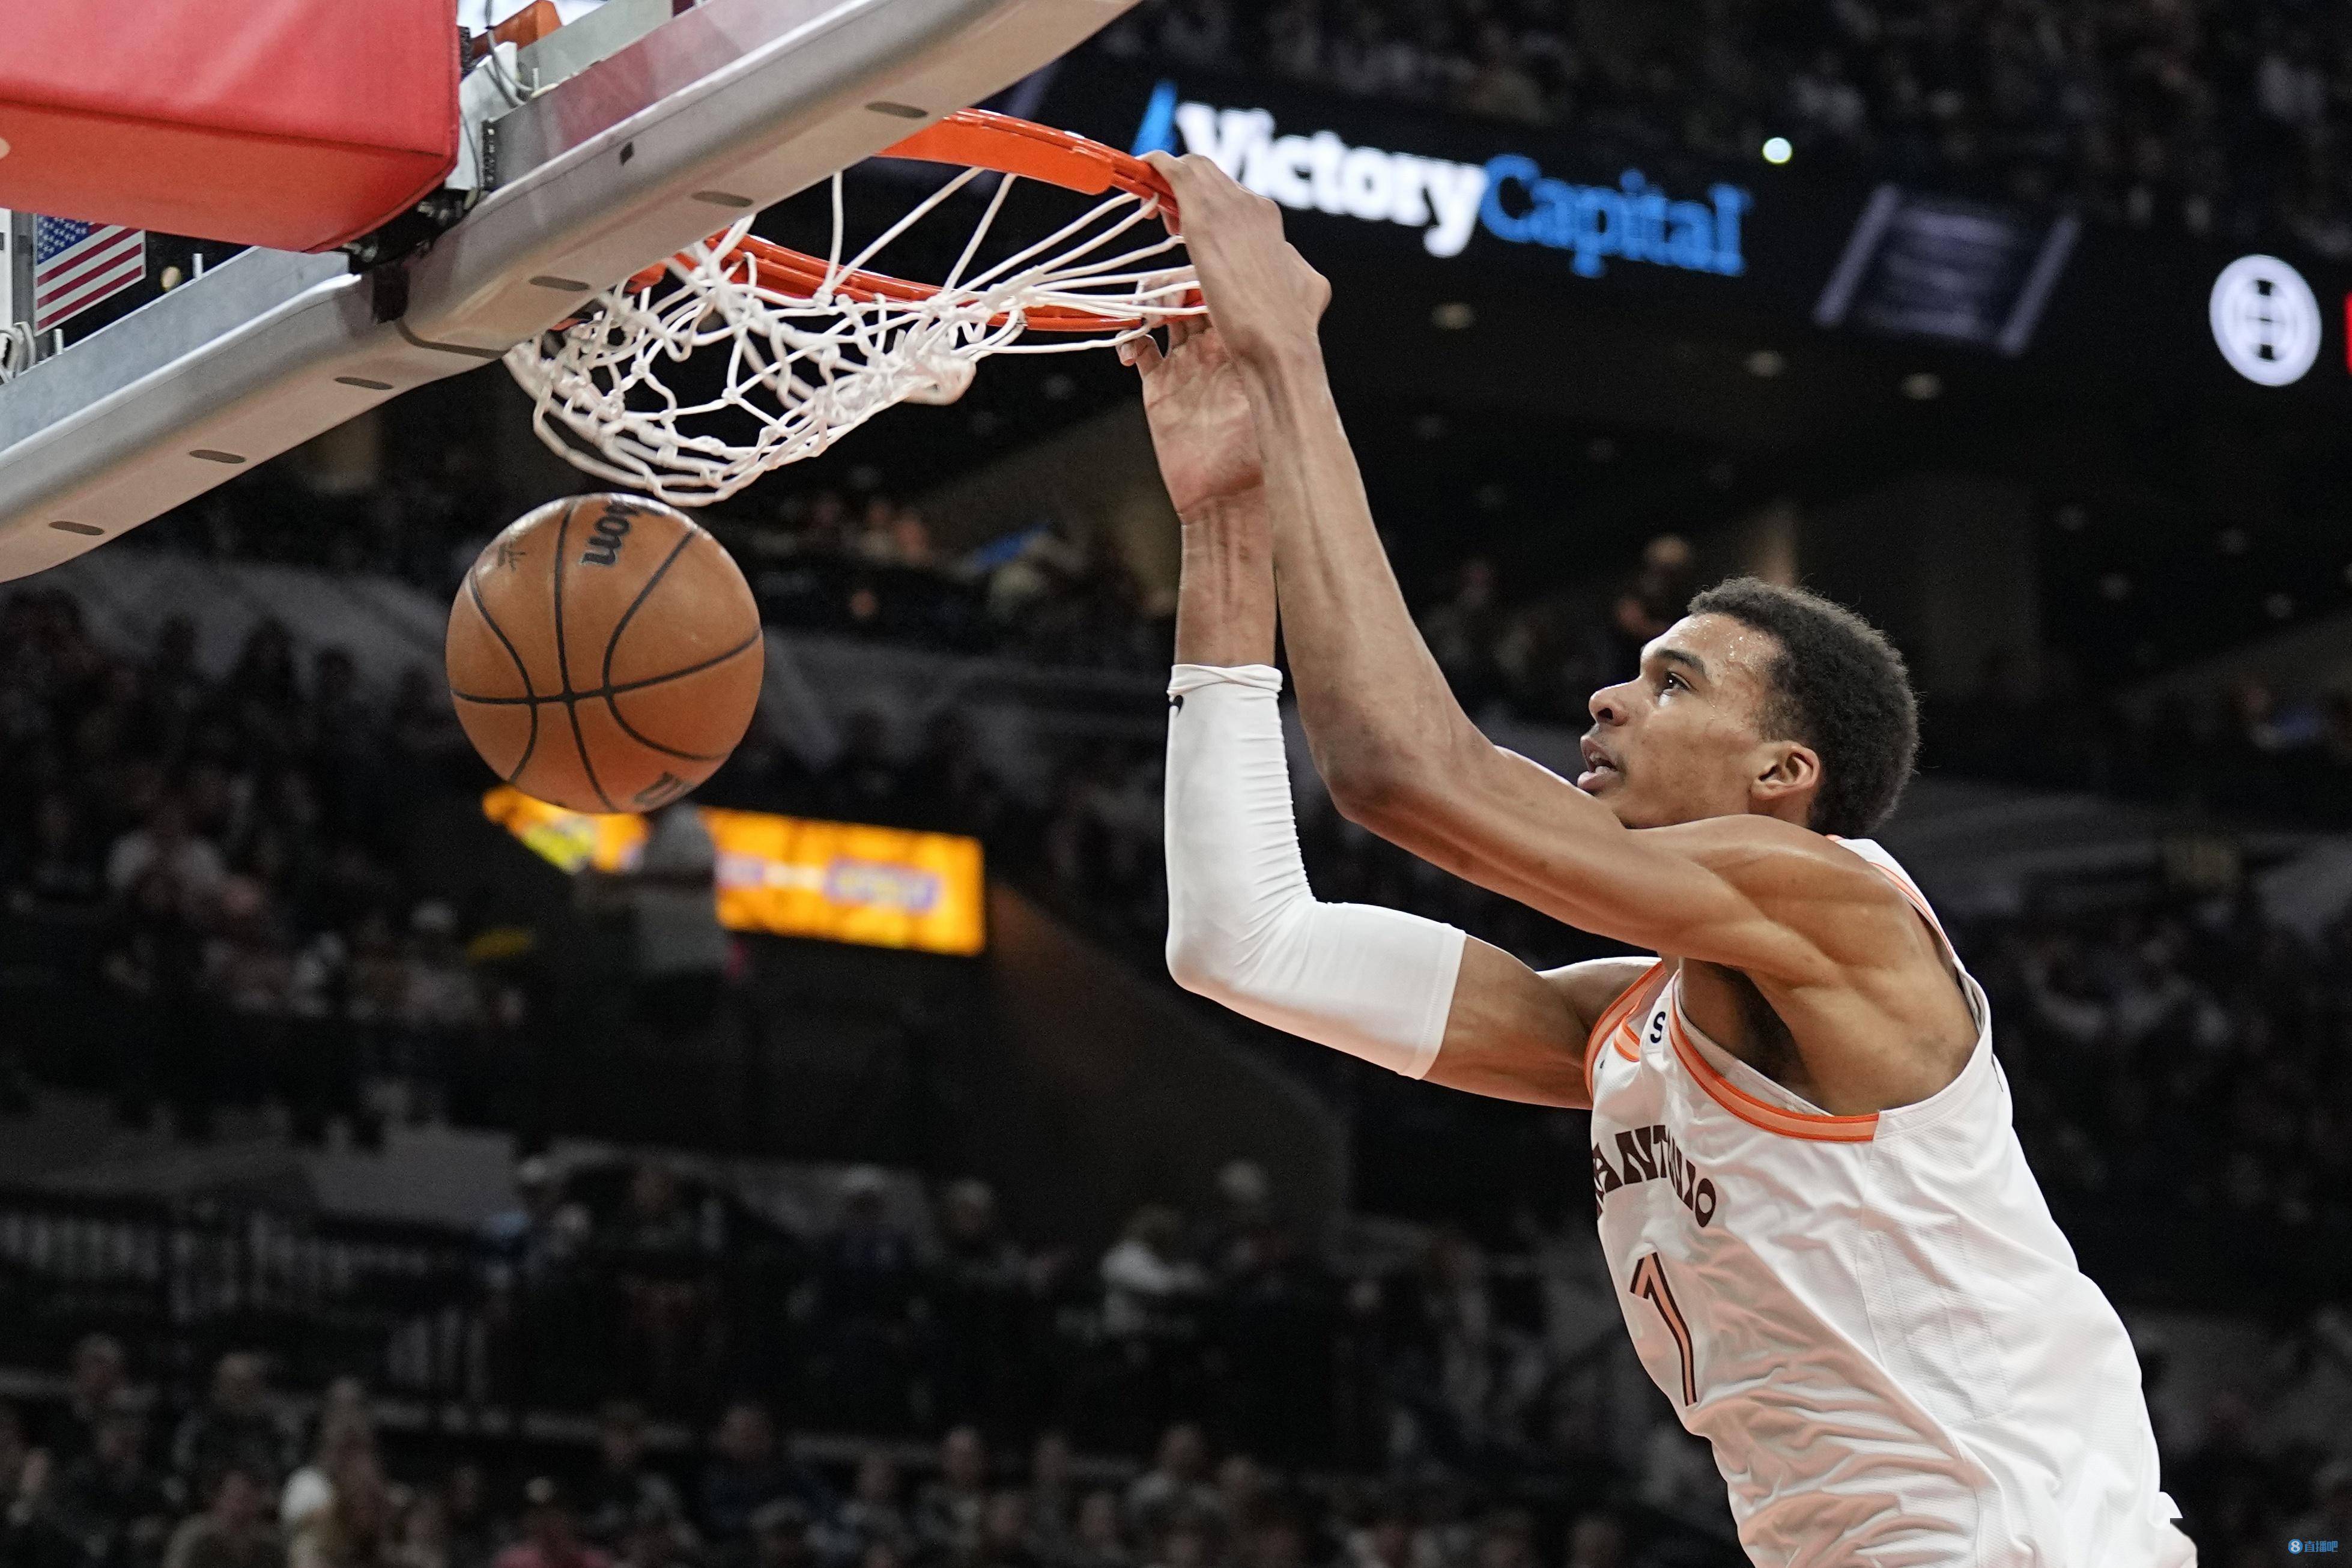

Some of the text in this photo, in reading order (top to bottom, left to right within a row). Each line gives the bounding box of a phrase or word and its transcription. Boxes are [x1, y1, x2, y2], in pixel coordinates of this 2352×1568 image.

[1176, 101, 1750, 277] Victory Capital
[1629, 1252, 1697, 1406] 1
